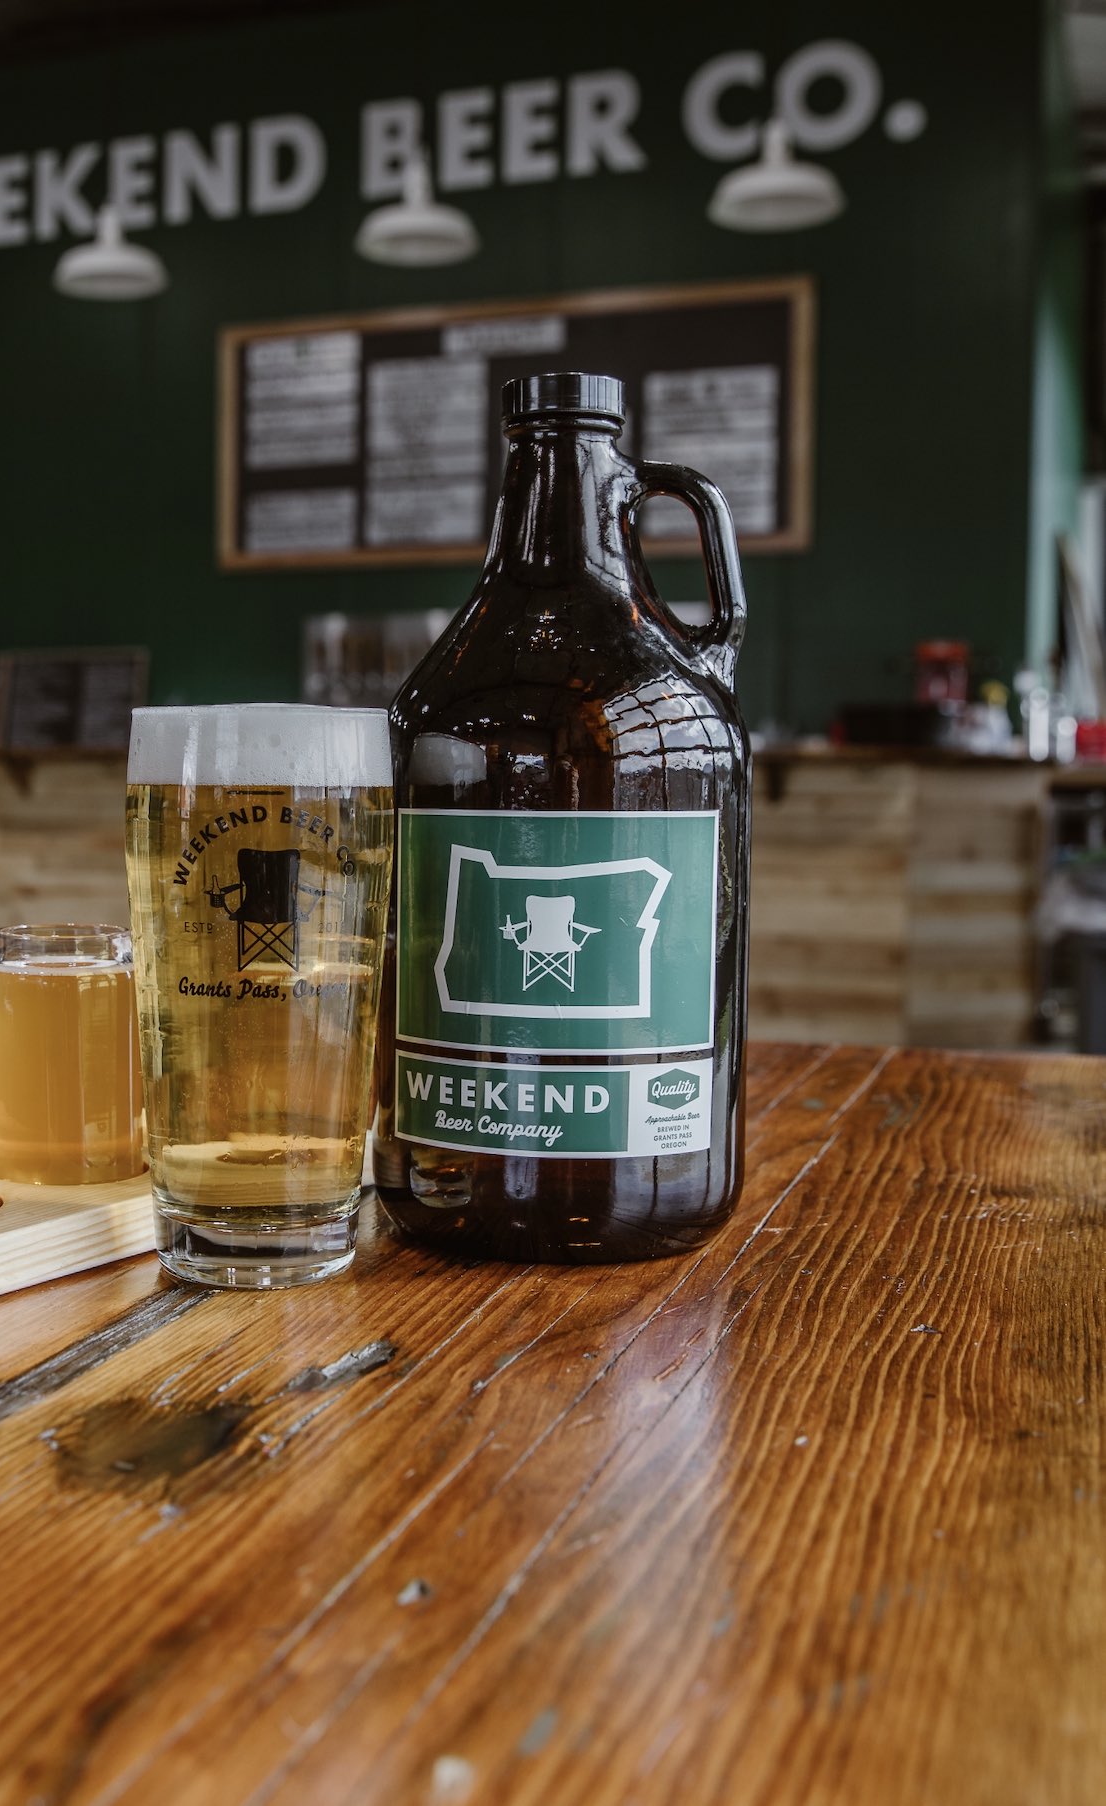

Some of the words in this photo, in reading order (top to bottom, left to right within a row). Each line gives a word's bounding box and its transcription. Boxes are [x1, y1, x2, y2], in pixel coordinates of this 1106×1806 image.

[360, 67, 647, 201] BEER
[682, 38, 928, 161] CO.
[173, 805, 268, 886] WEEKEND
[279, 806, 334, 844] BEER
[184, 921, 213, 934] ESTD
[318, 921, 348, 934] 201
[178, 976, 232, 998] Grants
[237, 978, 287, 1001] Pass,
[406, 1070, 610, 1114] WEEKEND
[651, 1079, 697, 1100] Quality
[435, 1109, 473, 1133] Beer
[477, 1115, 563, 1147] Company
[645, 1114, 687, 1125] Approachable
[687, 1112, 700, 1120] Beer
[657, 1125, 681, 1133] BREWED
[654, 1134, 678, 1142] GRANTS
[679, 1132, 692, 1140] PASS
[660, 1141, 688, 1150] OREGON
